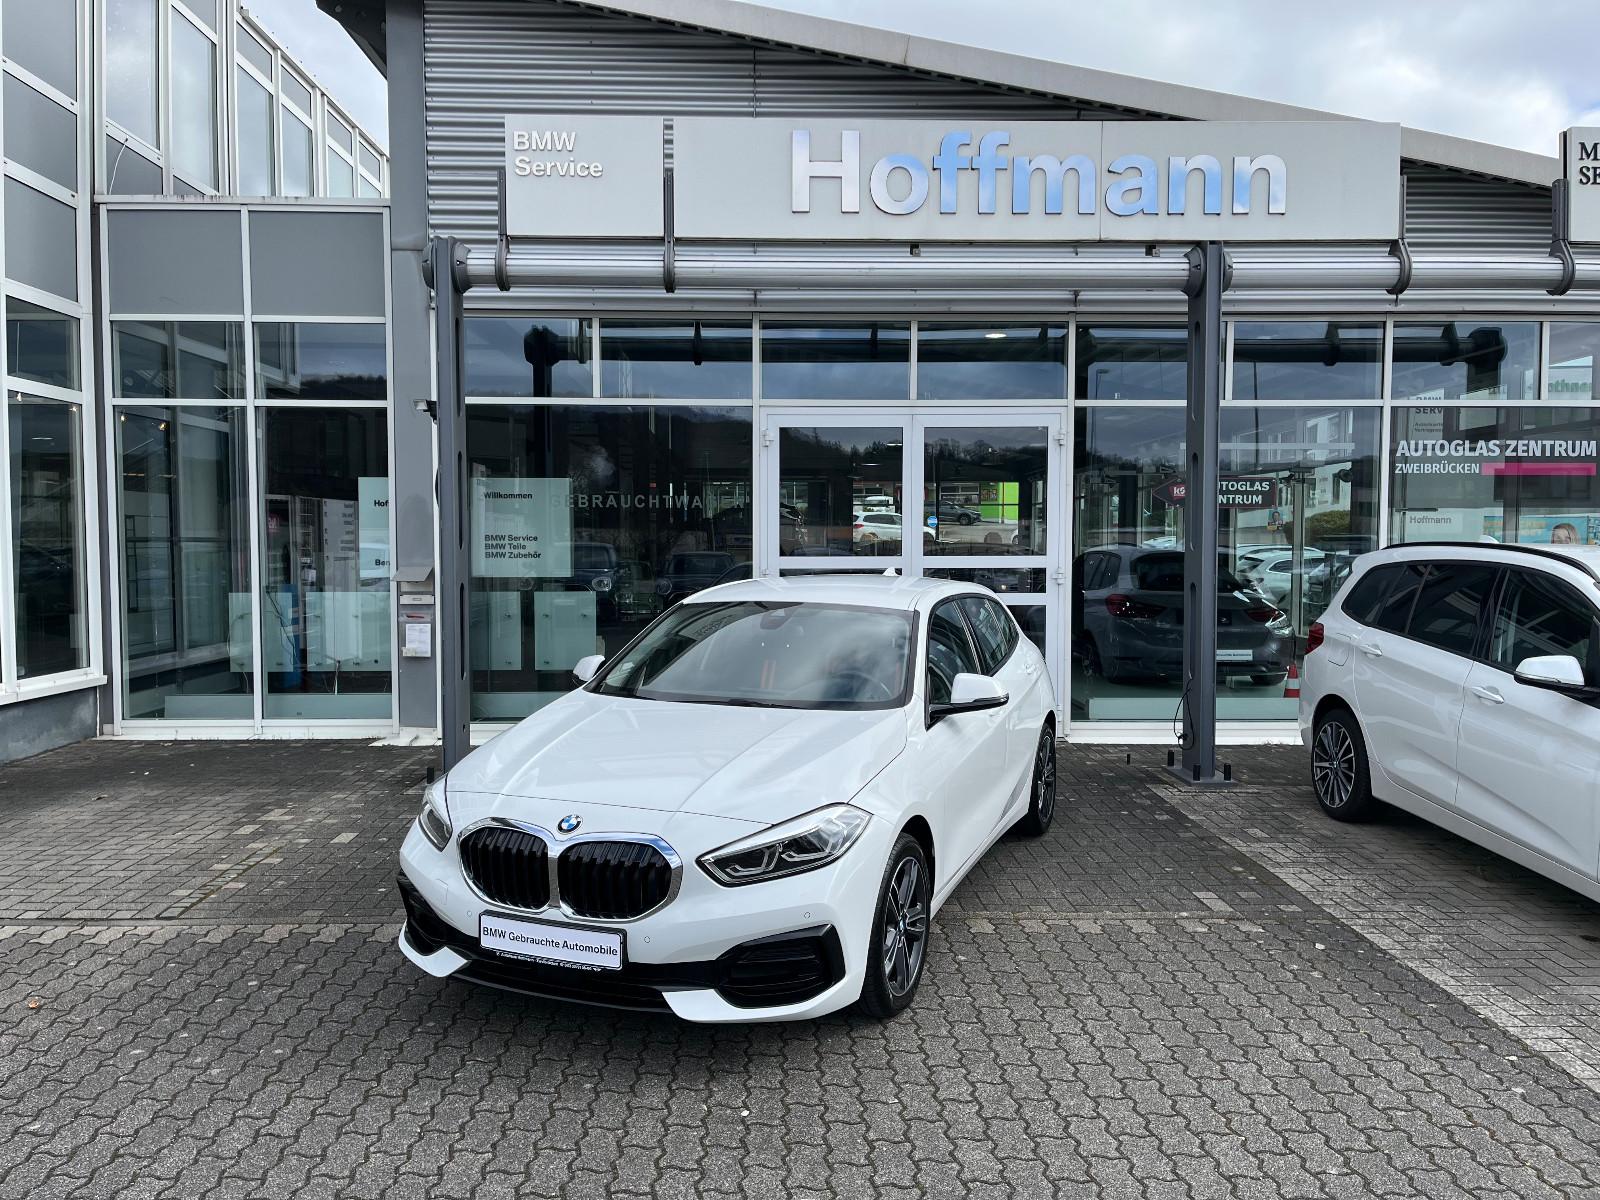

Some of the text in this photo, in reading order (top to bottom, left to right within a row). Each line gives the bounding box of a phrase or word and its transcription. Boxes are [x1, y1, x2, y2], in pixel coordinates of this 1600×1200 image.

[513, 130, 576, 152] BMW
[514, 155, 603, 177] Service
[792, 129, 1288, 216] Hoffmann
[1396, 440, 1597, 457] AUTOGLAS ZENTRUM
[1395, 461, 1480, 475] ZWEIBRÜCKEN
[1219, 481, 1270, 491] TOGLAS
[484, 491, 533, 500] Willkommen
[1409, 515, 1452, 525] Hoffmann
[508, 534, 538, 542] Service
[508, 542, 527, 550] Teile
[508, 551, 542, 559] Zubehör
[482, 926, 618, 956] BMW Gebrauchte Automobile
